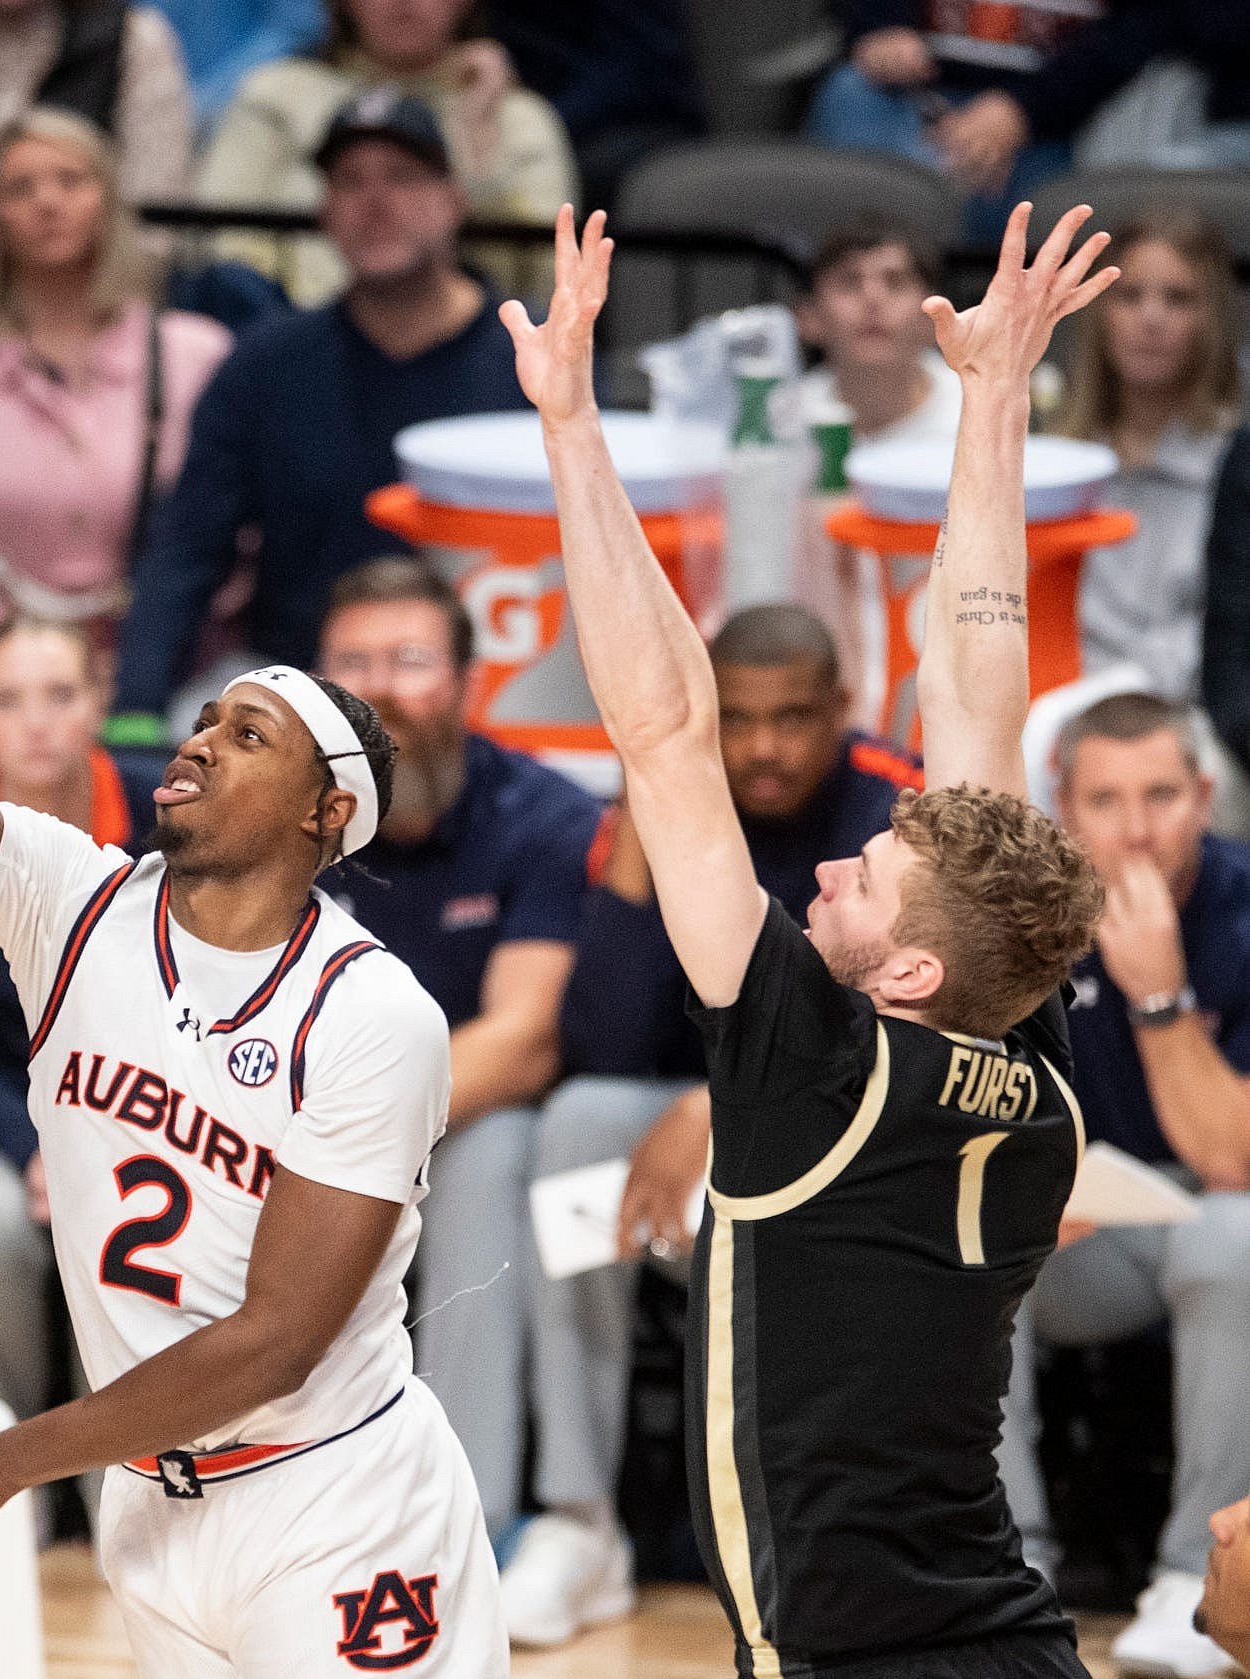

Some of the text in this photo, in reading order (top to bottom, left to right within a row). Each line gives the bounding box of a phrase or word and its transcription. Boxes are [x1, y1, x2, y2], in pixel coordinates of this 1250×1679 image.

[960, 587, 987, 604] gain
[229, 1039, 278, 1087] SEC
[99, 1153, 193, 1308] 2
[957, 1131, 1012, 1265] 1
